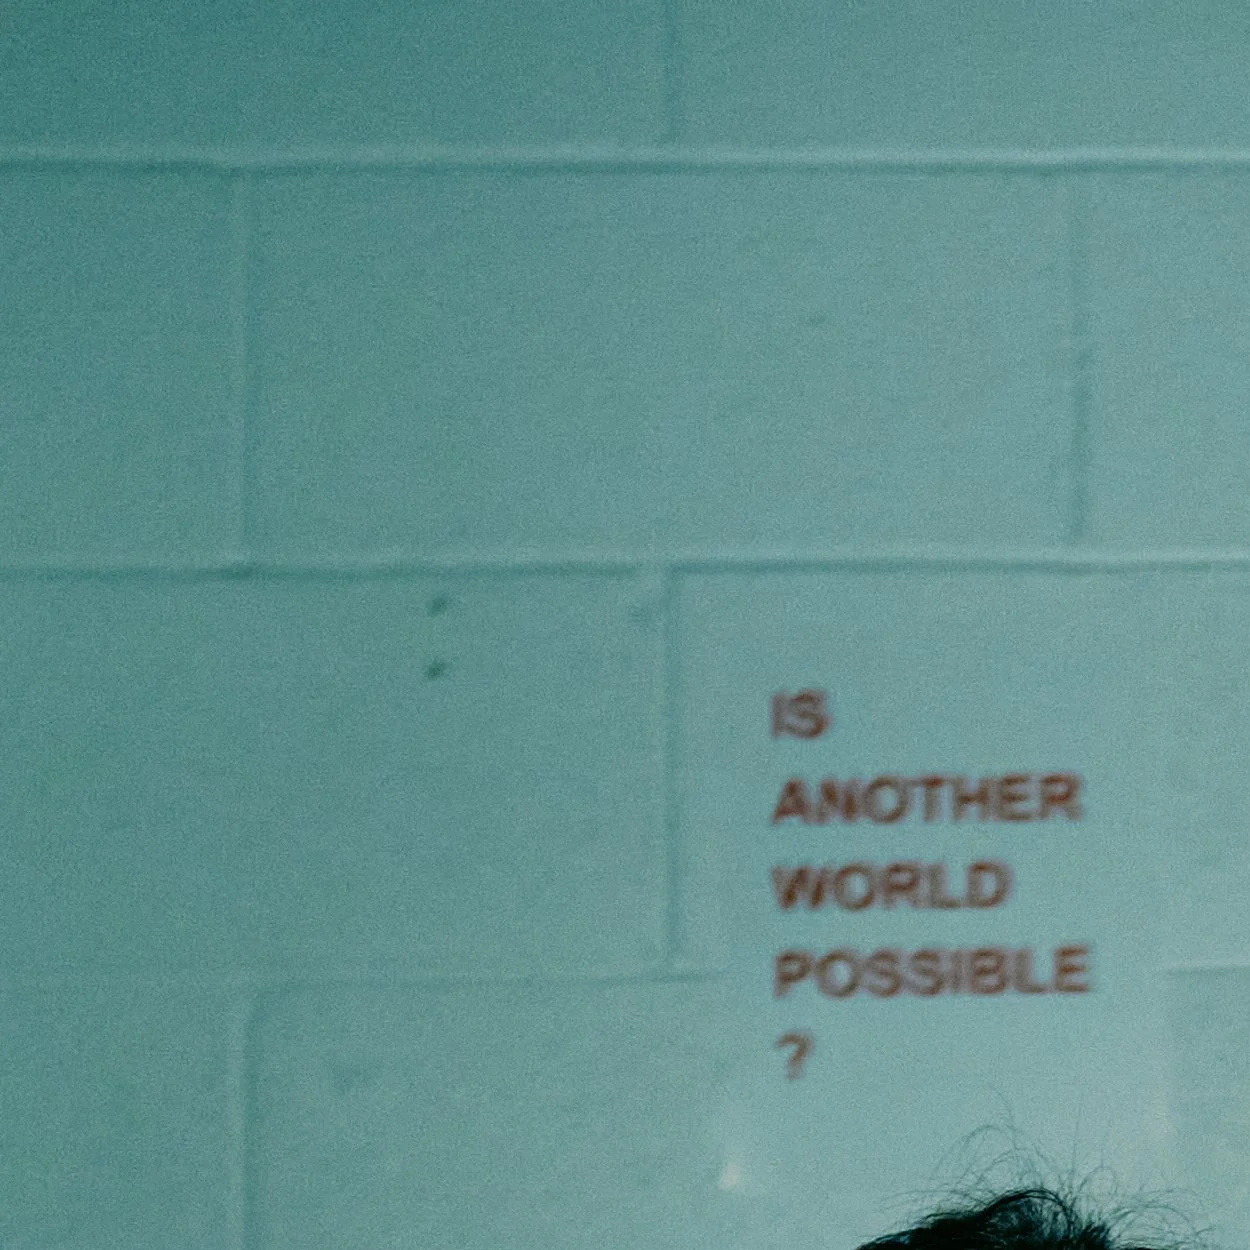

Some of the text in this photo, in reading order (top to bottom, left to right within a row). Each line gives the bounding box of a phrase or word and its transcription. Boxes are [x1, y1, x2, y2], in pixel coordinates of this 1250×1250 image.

[771, 688, 831, 739] IS
[772, 773, 1083, 825] ANOTHER
[772, 860, 1015, 911] WORLD
[774, 943, 1093, 998] POSSIBLE
[776, 1029, 815, 1080] ?
